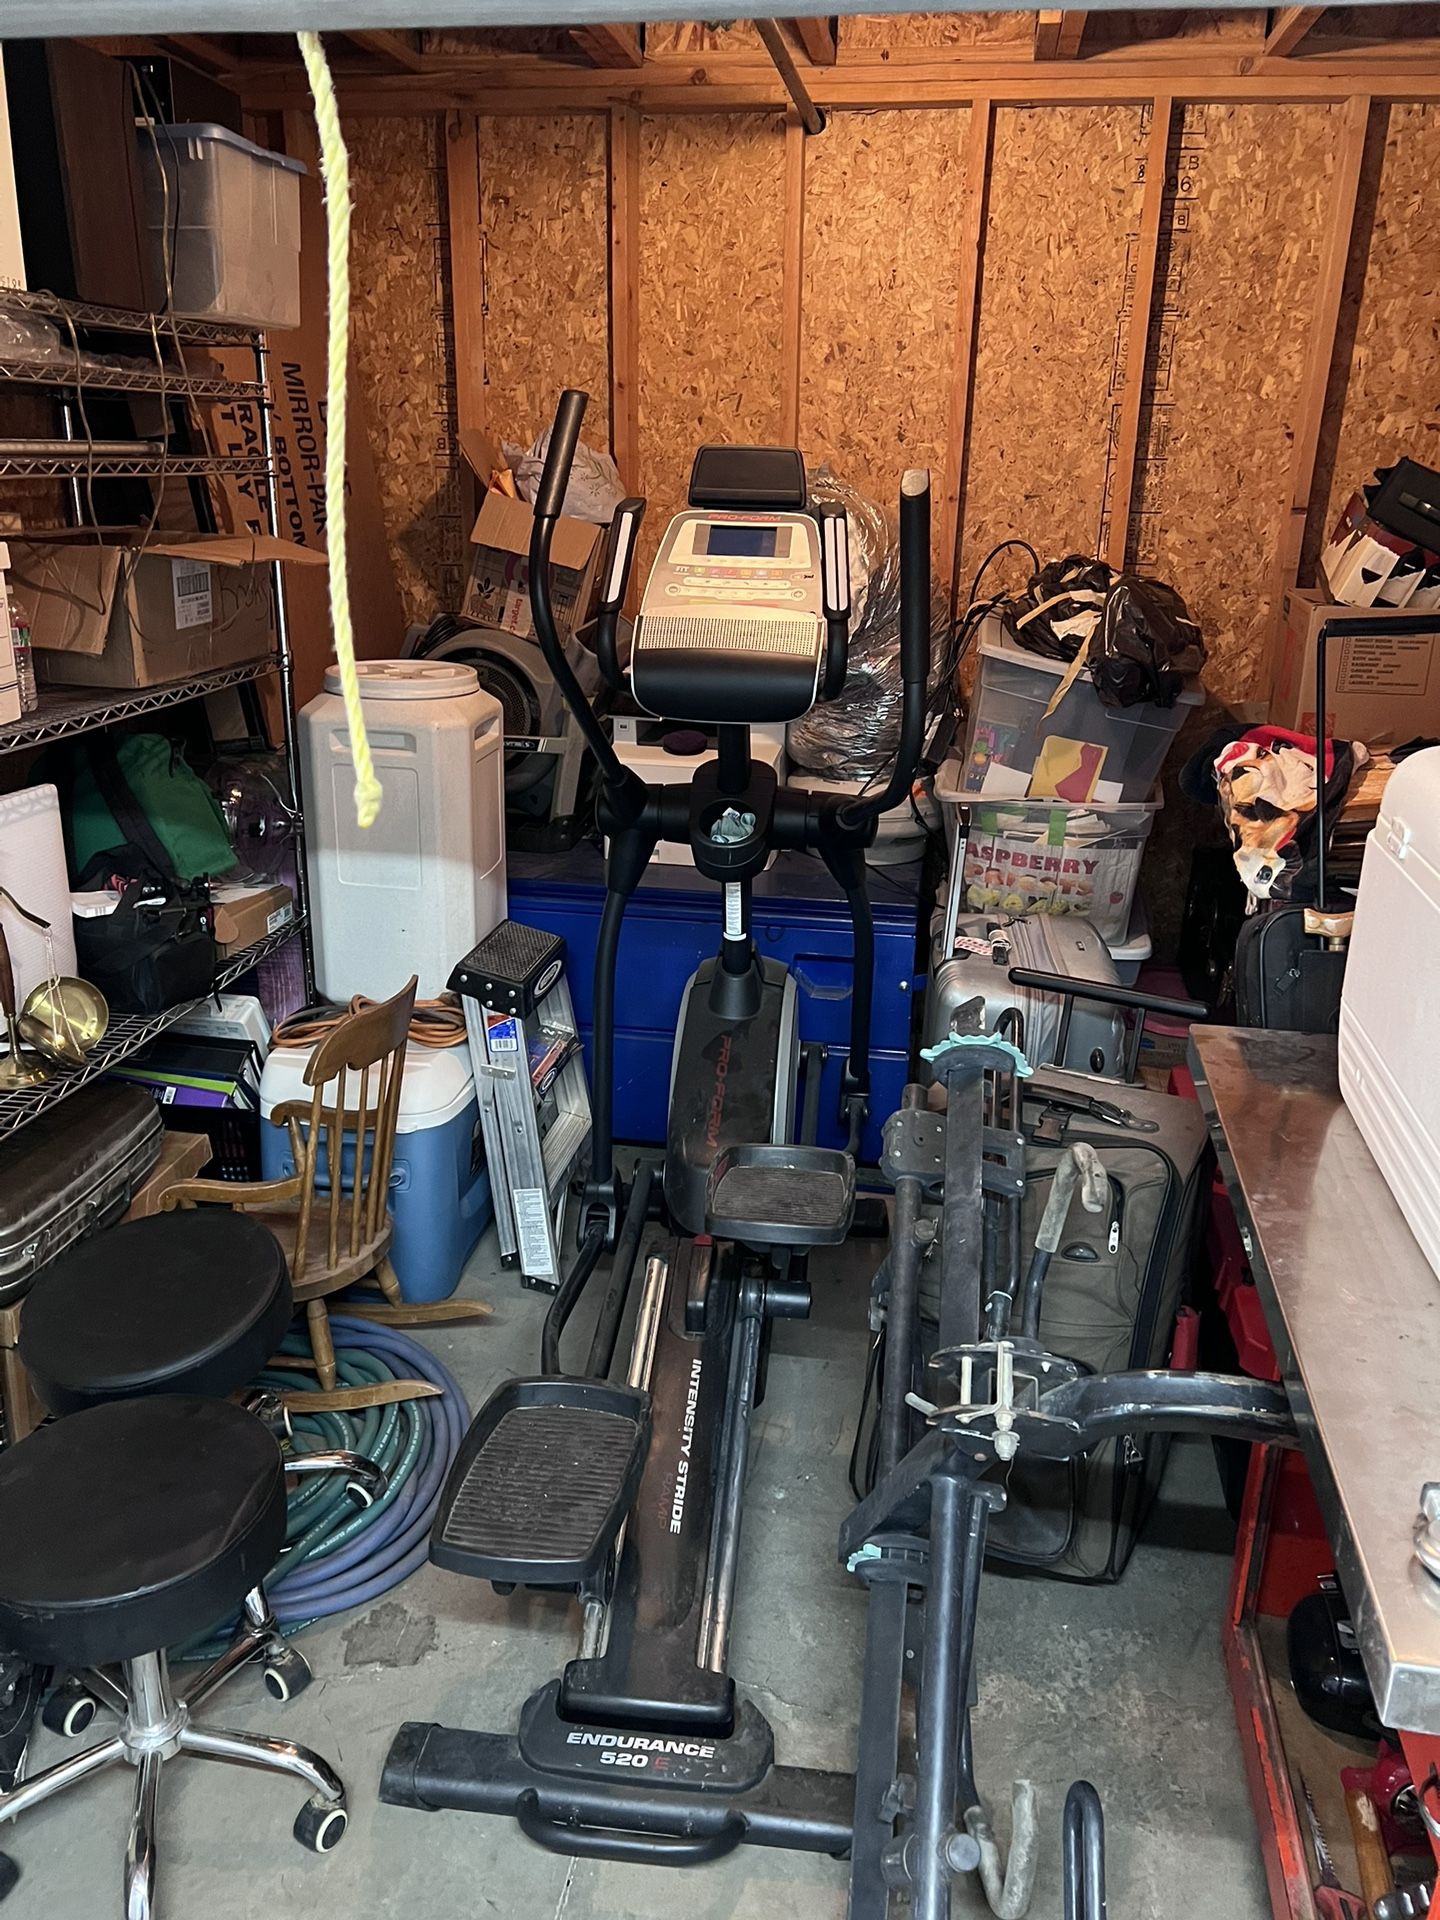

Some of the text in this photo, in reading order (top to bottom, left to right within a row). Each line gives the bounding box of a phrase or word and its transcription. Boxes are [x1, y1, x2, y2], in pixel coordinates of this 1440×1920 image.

[282, 361, 327, 535] MIRROR-PAK
[707, 512, 782, 522] PRO-FORM
[966, 842, 1099, 875] ASPBERRY
[706, 1034, 732, 1148] PRO-FORM
[669, 1358, 702, 1534] INTENSITY STRIDE
[566, 1732, 716, 1759] ENDURANCE
[600, 1751, 671, 1771] 520 E
